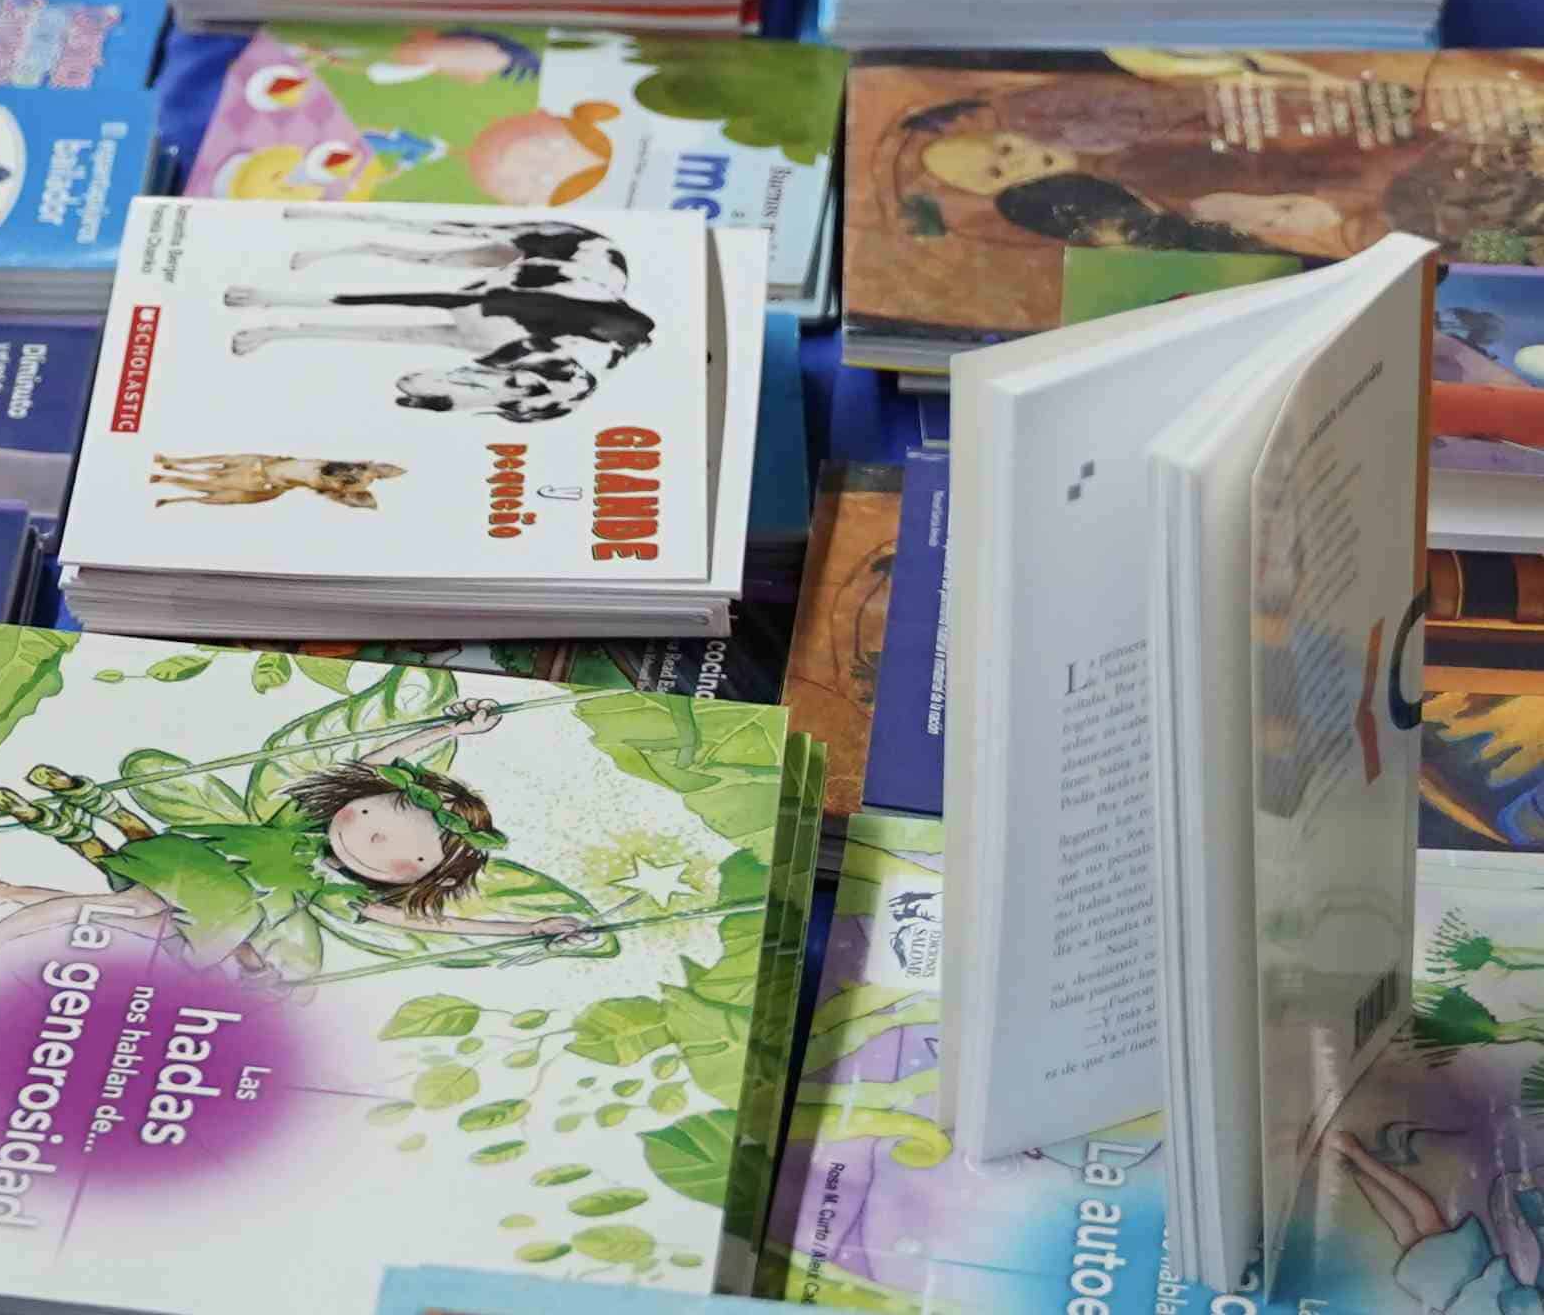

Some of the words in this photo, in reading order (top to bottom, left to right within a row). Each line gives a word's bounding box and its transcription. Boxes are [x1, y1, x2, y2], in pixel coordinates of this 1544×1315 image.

[38, 138, 94, 227] bailador
[162, 249, 184, 283] Berger
[8, 343, 47, 419] Diminuto
[117, 321, 154, 431] SCHOLASTIC
[486, 443, 537, 539] pequeño
[591, 426, 661, 561] GRANDE
[660, 652, 678, 679] Read
[926, 709, 944, 735] nación
[71, 904, 136, 950] La
[125, 985, 154, 1024] nos
[101, 1028, 151, 1099] hablan
[140, 1007, 243, 1146] hadas
[235, 1066, 272, 1101] Las
[78, 1104, 124, 1153] de...
[825, 1162, 846, 1191] Rosa
[1084, 1140, 1148, 1187] La
[814, 1208, 837, 1241] Curto
[806, 1248, 827, 1279] Aleix
